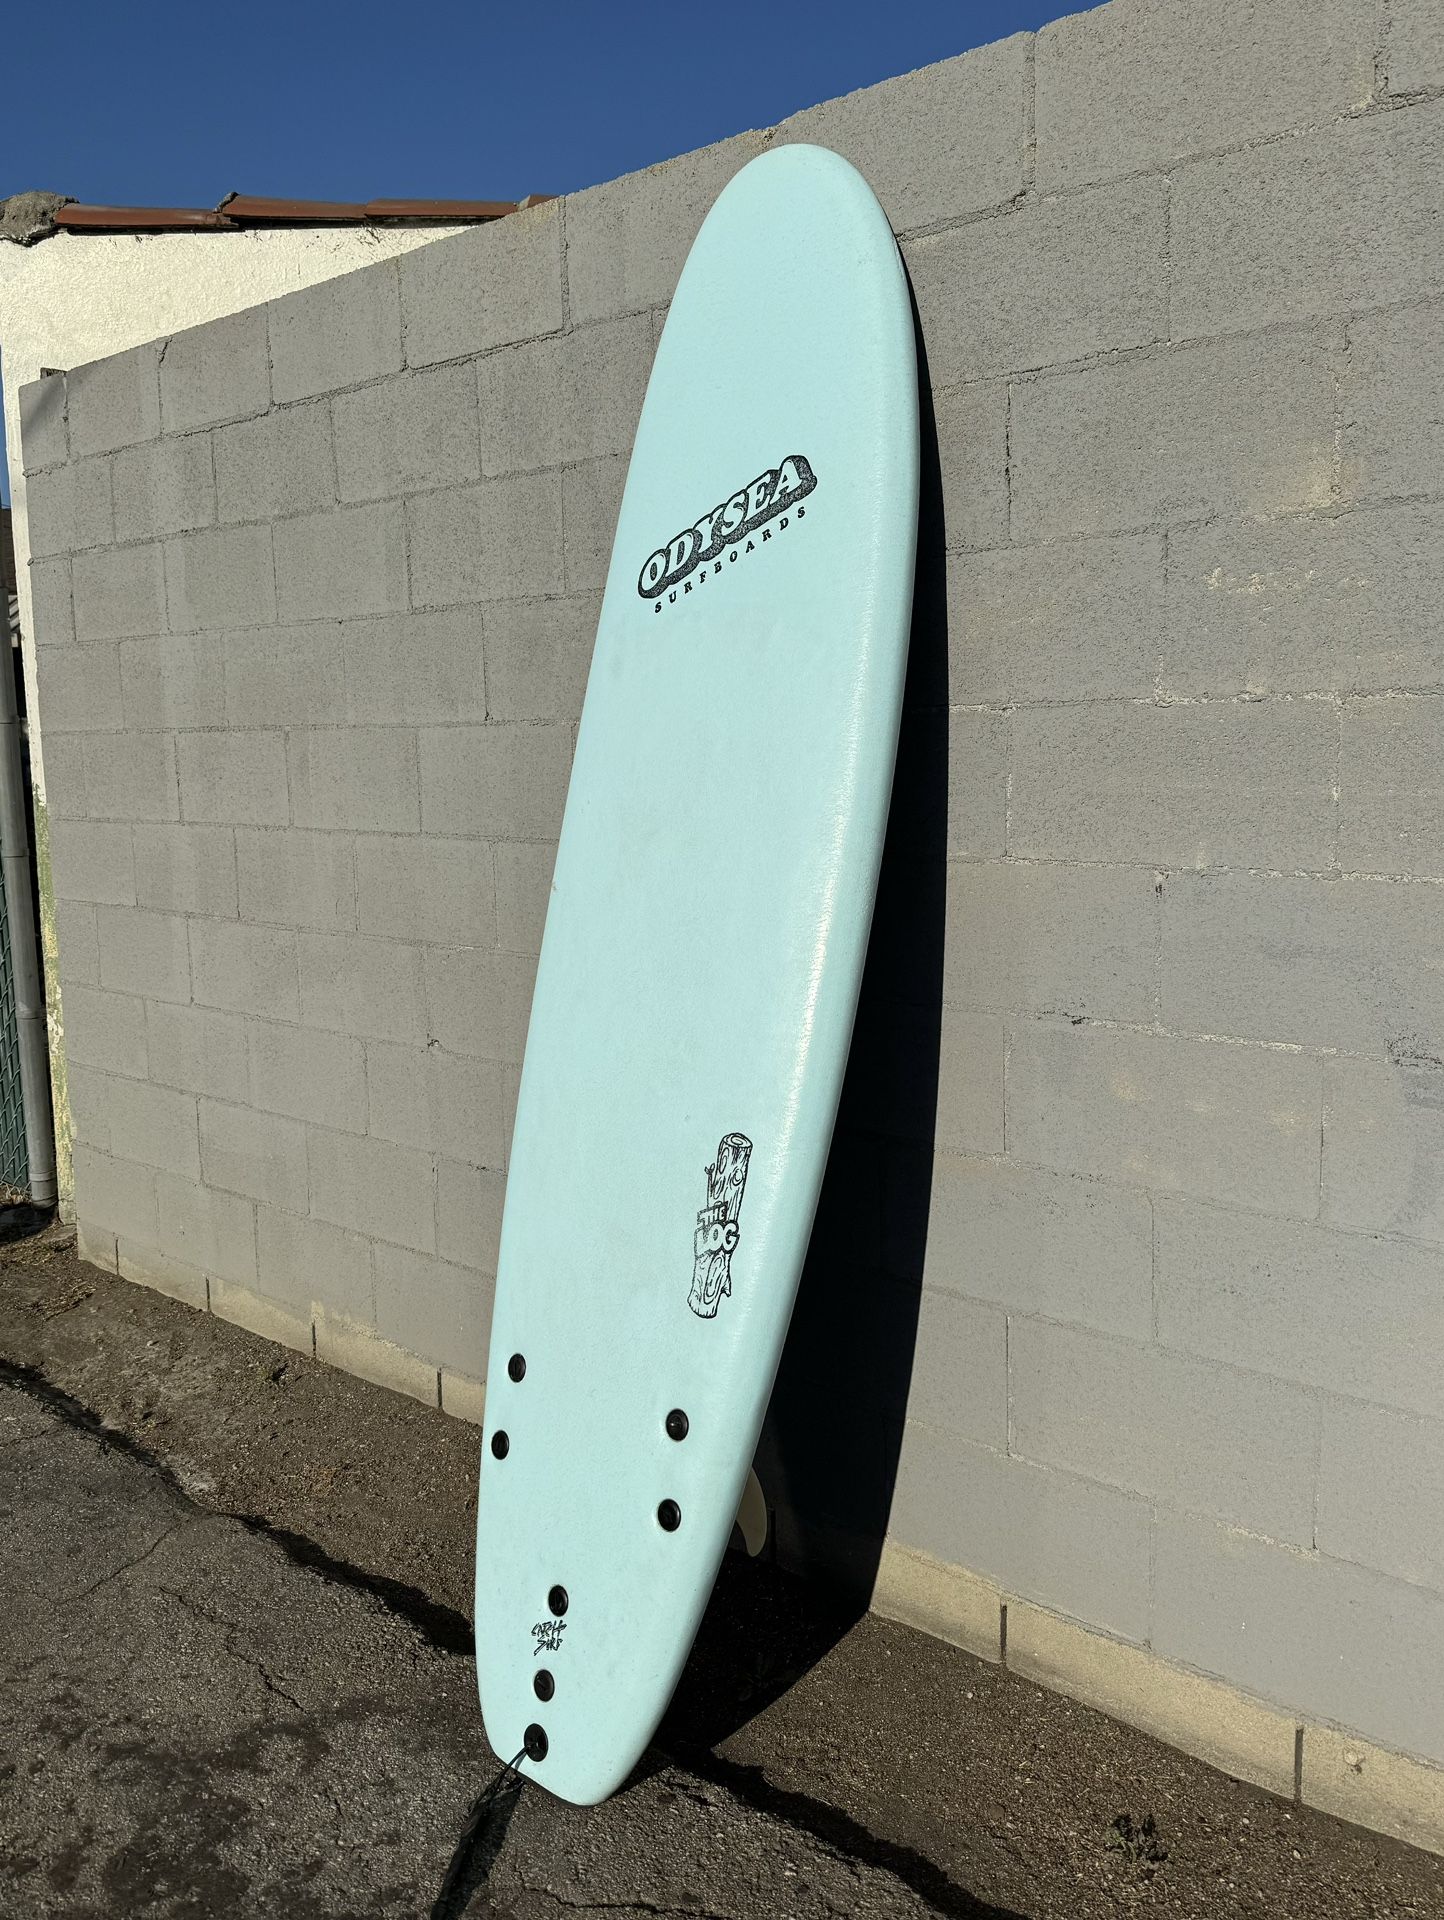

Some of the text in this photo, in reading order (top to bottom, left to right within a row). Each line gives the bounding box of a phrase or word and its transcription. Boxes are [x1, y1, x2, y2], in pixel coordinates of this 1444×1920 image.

[638, 455, 817, 599] ODYSEA
[654, 506, 806, 613] SURFBOARDS
[694, 1220, 740, 1259] LOG
[697, 1201, 728, 1226] THE
